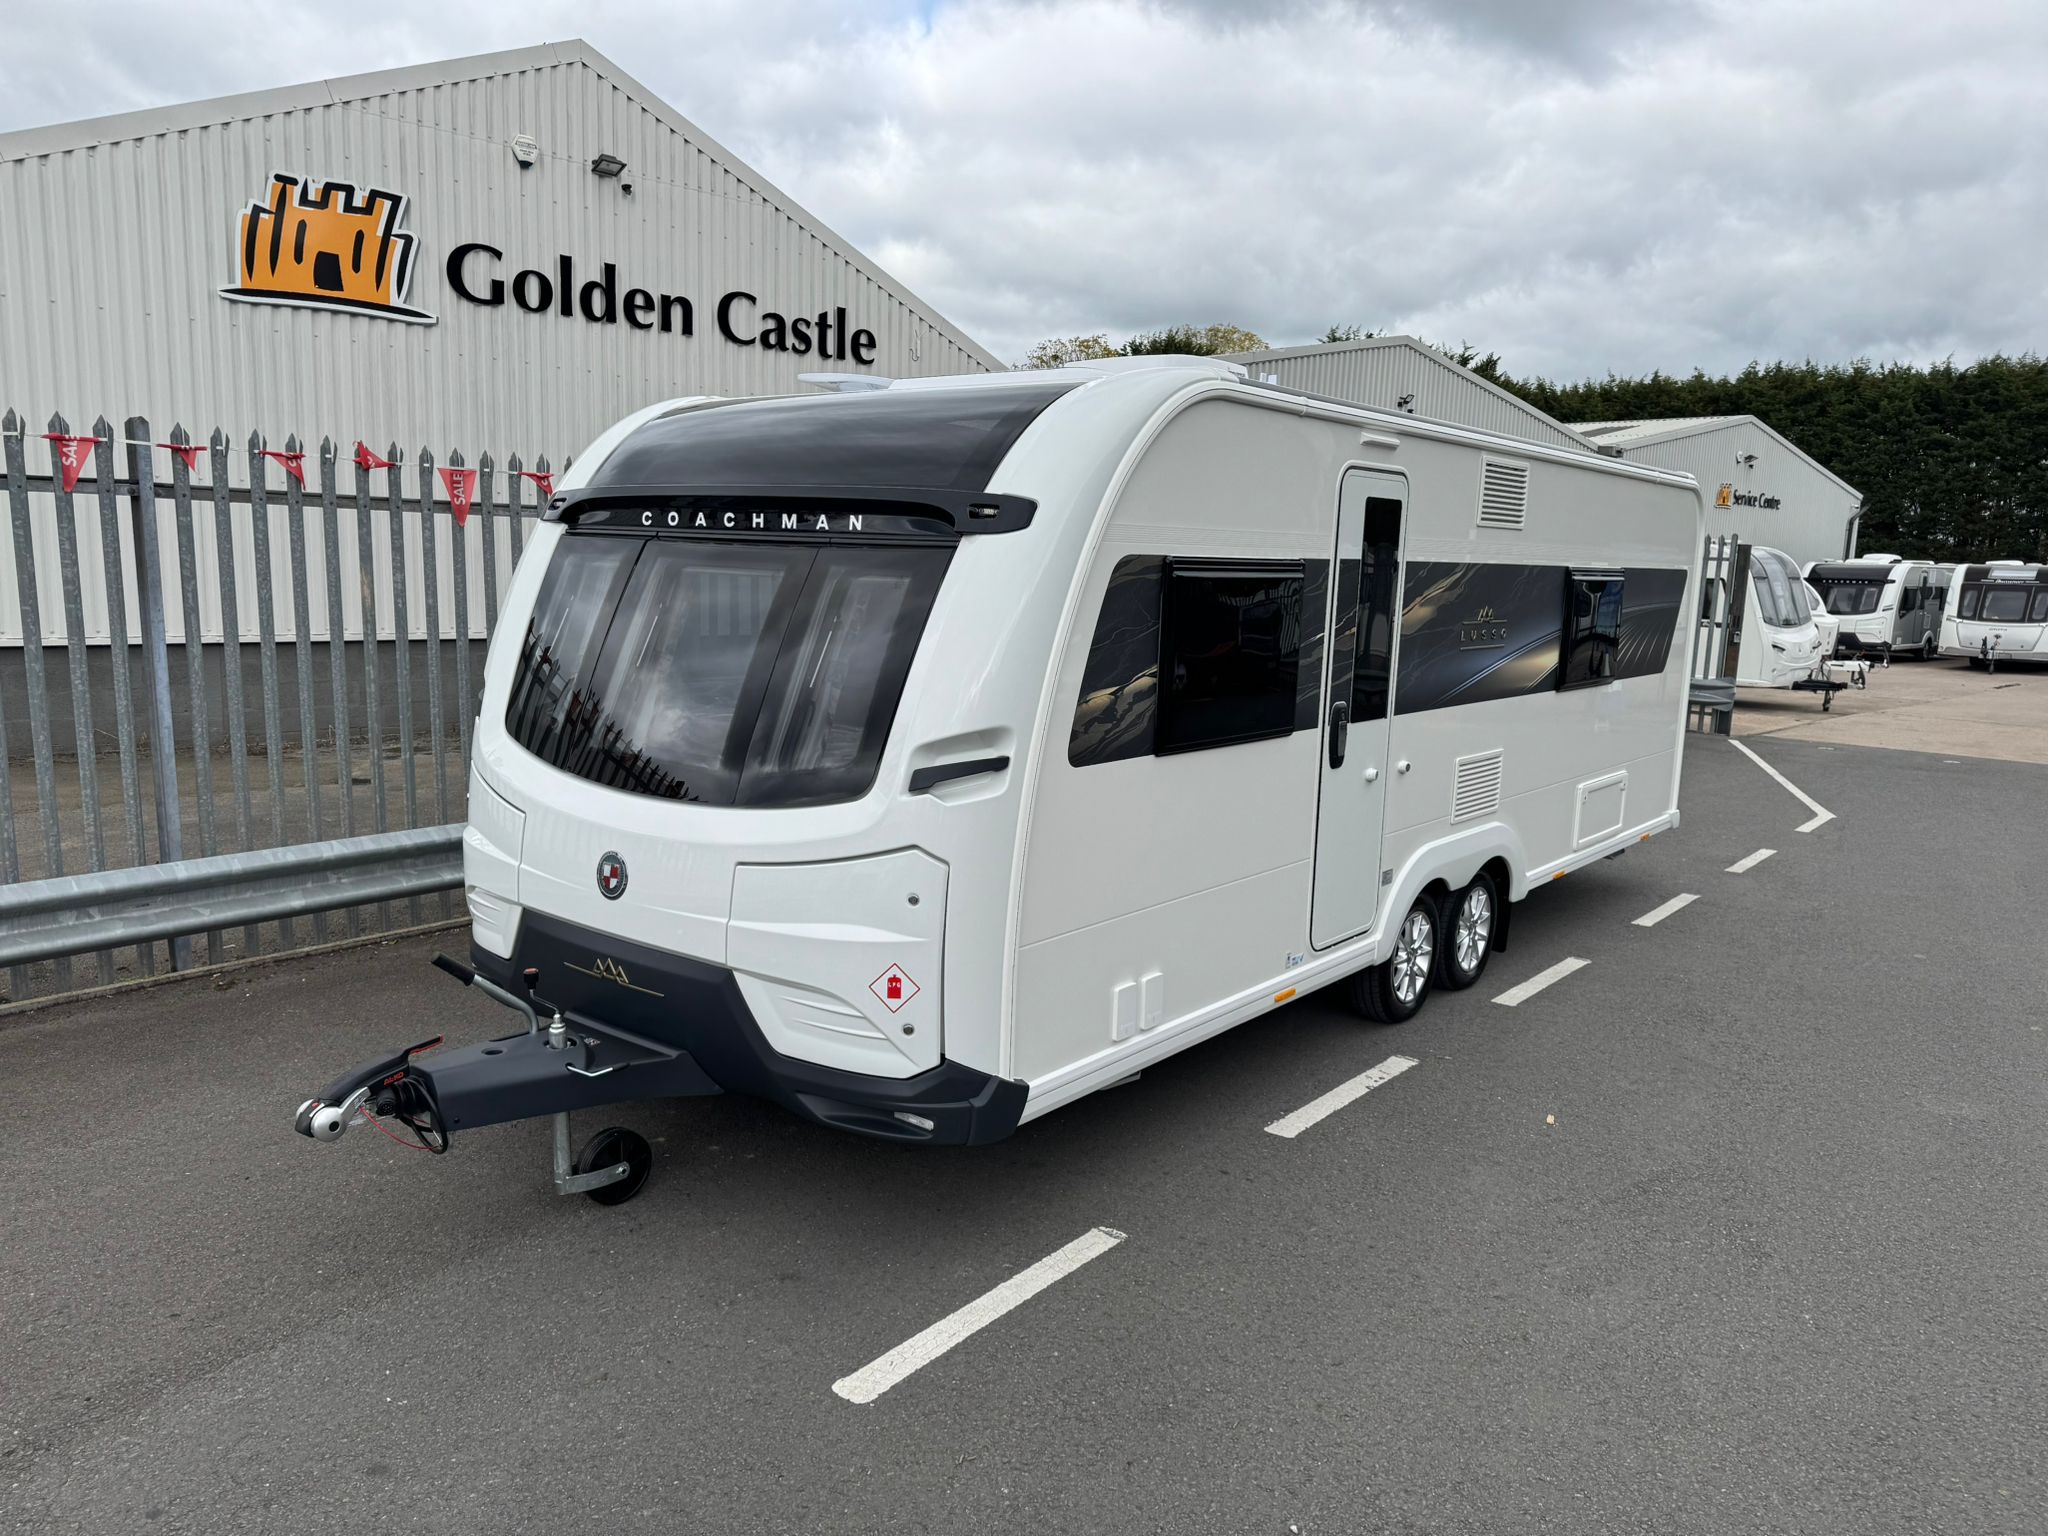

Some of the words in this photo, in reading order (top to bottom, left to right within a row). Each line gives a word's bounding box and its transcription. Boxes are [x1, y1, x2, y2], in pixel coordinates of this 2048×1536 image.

[446, 243, 694, 336] Golden
[717, 291, 877, 365] Castle
[452, 472, 466, 506] SALE
[1732, 488, 1758, 508] Service
[641, 511, 862, 531] COACHMAN
[1460, 628, 1507, 642] LUSSO
